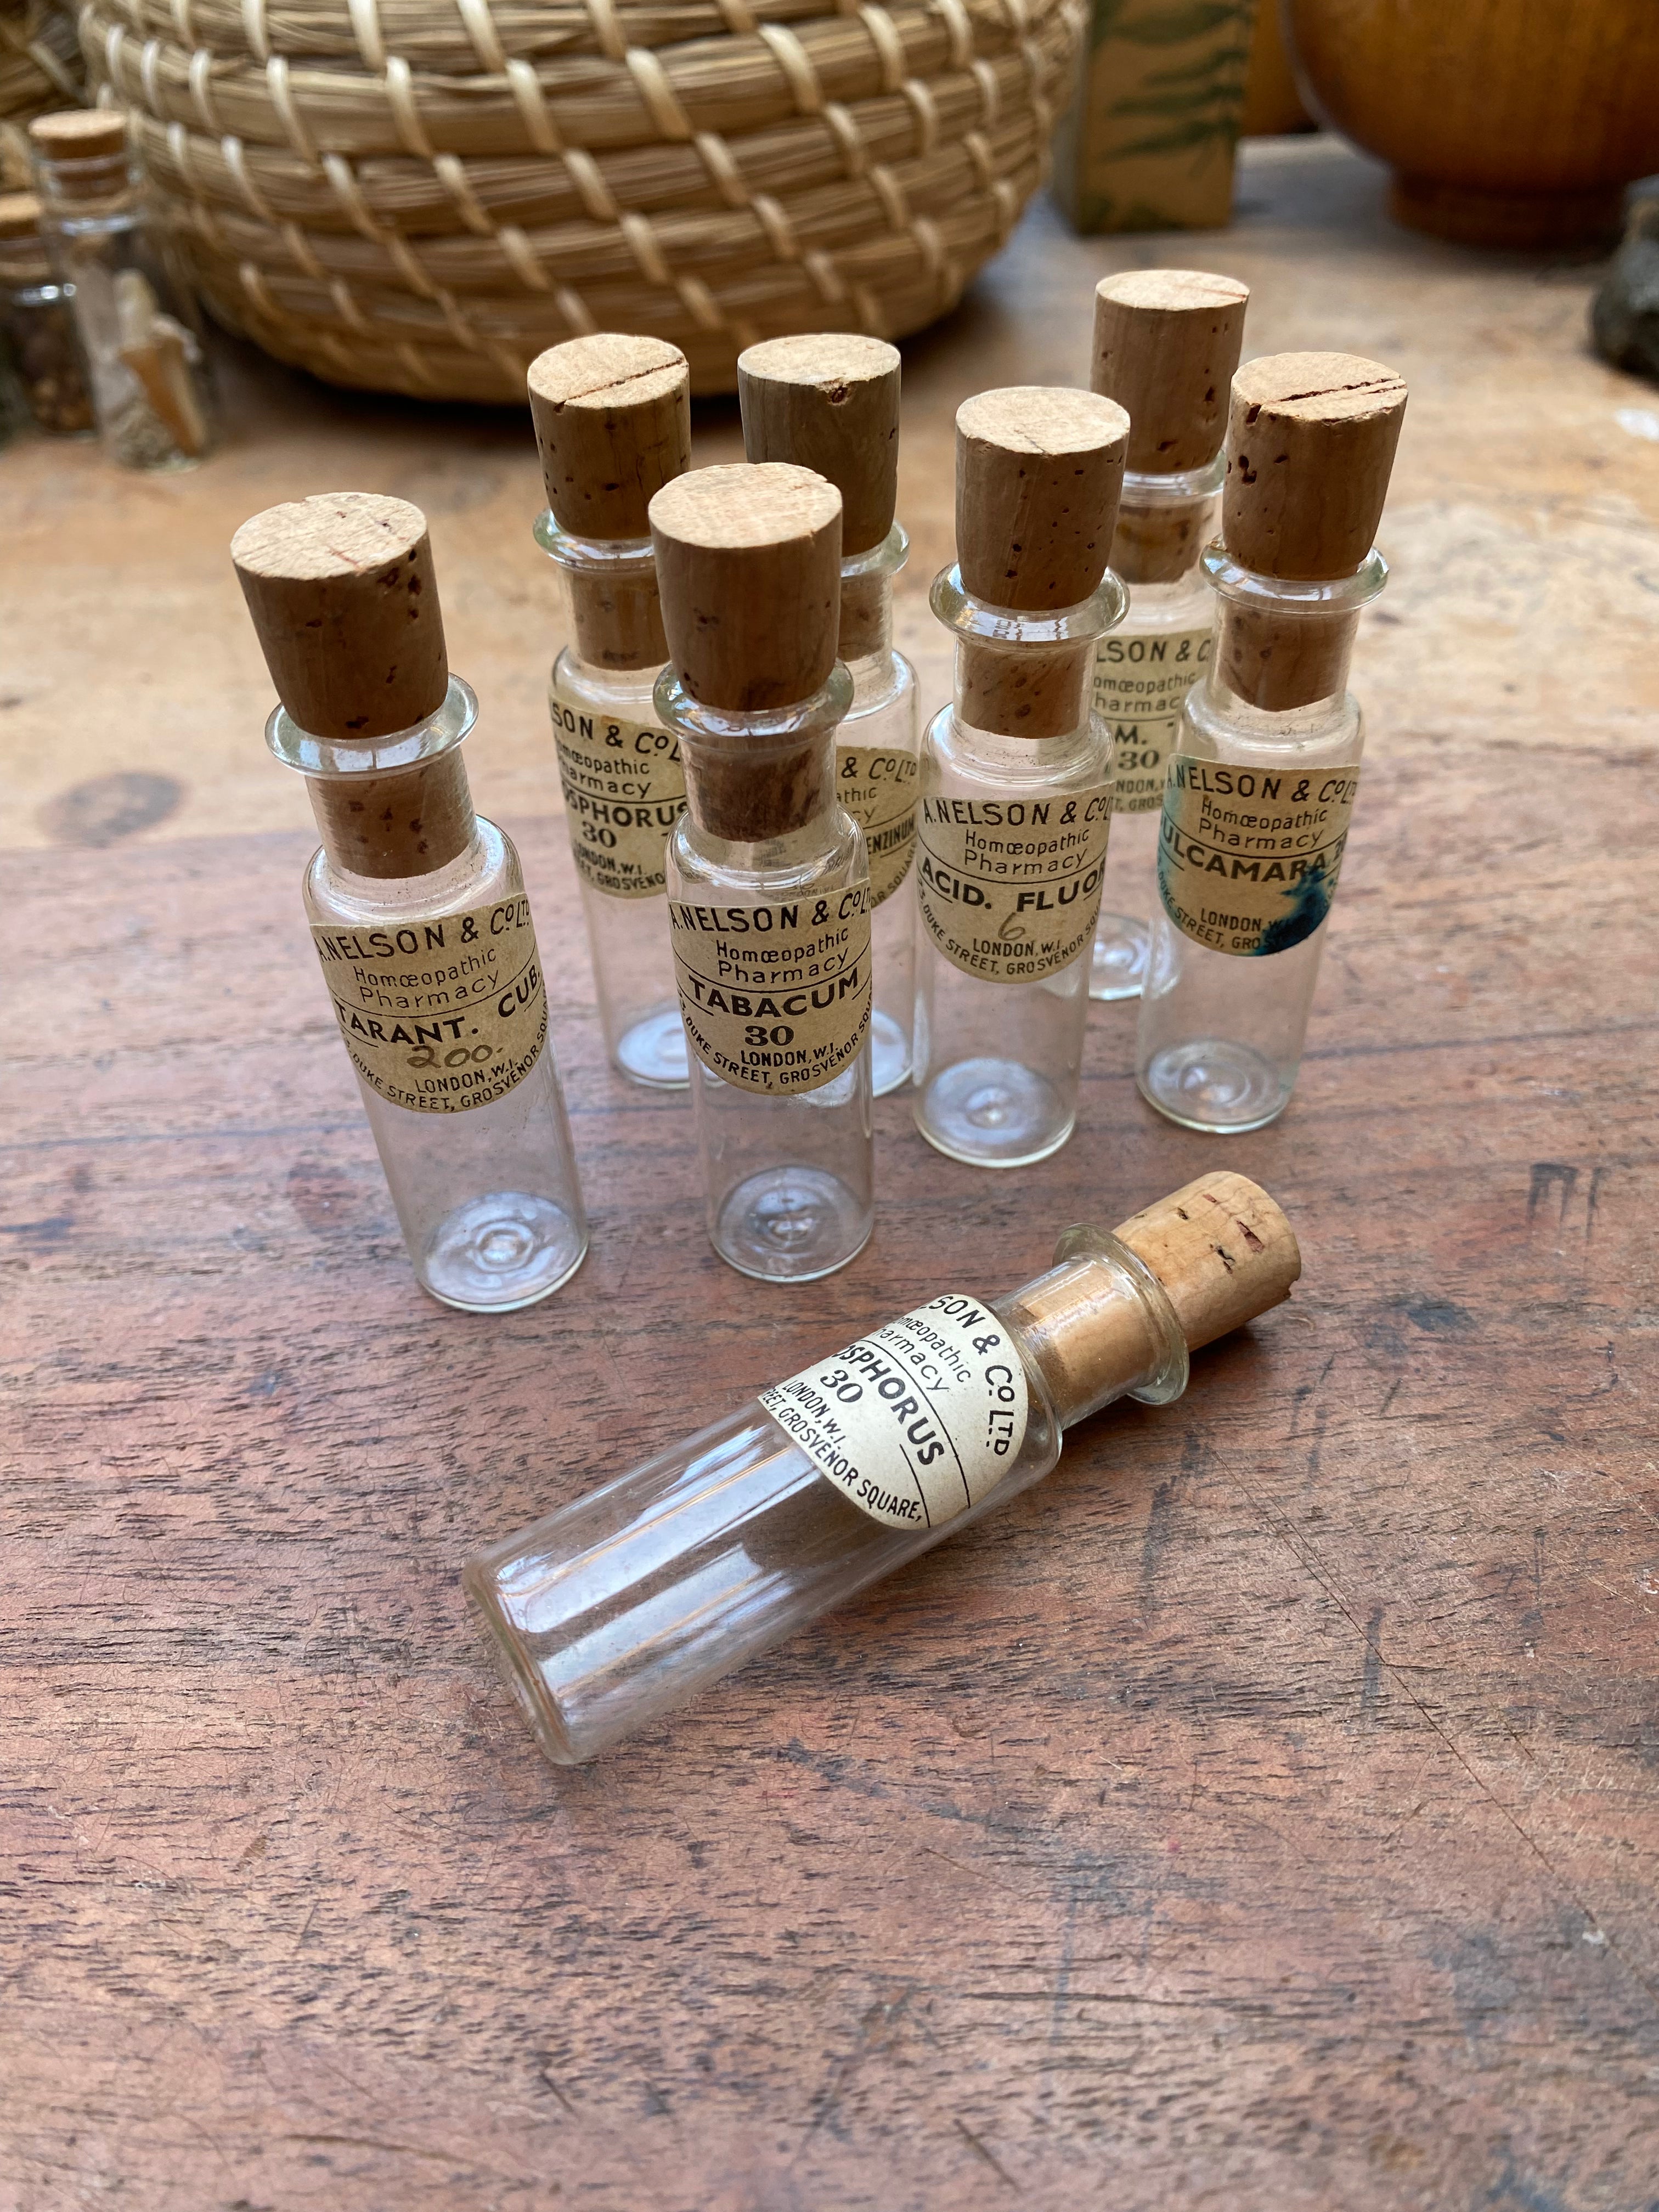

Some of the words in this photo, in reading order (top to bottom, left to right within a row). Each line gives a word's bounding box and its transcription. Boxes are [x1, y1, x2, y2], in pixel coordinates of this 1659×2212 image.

[1175, 639, 1191, 662] &
[605, 725, 624, 749] &
[841, 756, 859, 778] &
[1118, 749, 1160, 770] 30
[1291, 779, 1310, 802] &
[1059, 801, 1077, 825] &
[582, 821, 617, 848] 30
[966, 828, 1090, 857] Homœopathic
[1199, 818, 1324, 850] Pharmacy
[964, 848, 1087, 875] Pharmacy
[922, 857, 992, 910] ACID.
[811, 900, 830, 926] &
[460, 916, 479, 944] &
[923, 904, 946, 941] DUKE
[945, 938, 1000, 975] STREET,
[1006, 934, 1085, 975] GROSVENOR
[716, 928, 849, 964] Homœopathic
[973, 938, 1039, 957] LONDON,
[353, 948, 496, 988] Homœopathic
[718, 947, 849, 984] Pharmacy
[359, 969, 499, 1008] Pharmacy
[688, 967, 859, 1018] TABACUM
[334, 998, 479, 1045] TARANT.
[744, 1025, 794, 1047] 30
[685, 1017, 712, 1054] DUKE
[713, 1052, 773, 1085] STREET,
[780, 1034, 859, 1085] GROSVENOR
[741, 1049, 812, 1068] LONDON,
[353, 1053, 383, 1090] DUKE
[386, 1085, 455, 1112] STREET,
[460, 1044, 539, 1108] GROSVENOR
[415, 1069, 492, 1094] LONDON,
[972, 1334, 1001, 1356] &
[820, 1369, 863, 1403] 30
[782, 1379, 831, 1424] LONDON,
[778, 1407, 859, 1486] GROSVENOR
[856, 1479, 923, 1522] SQUARE,
